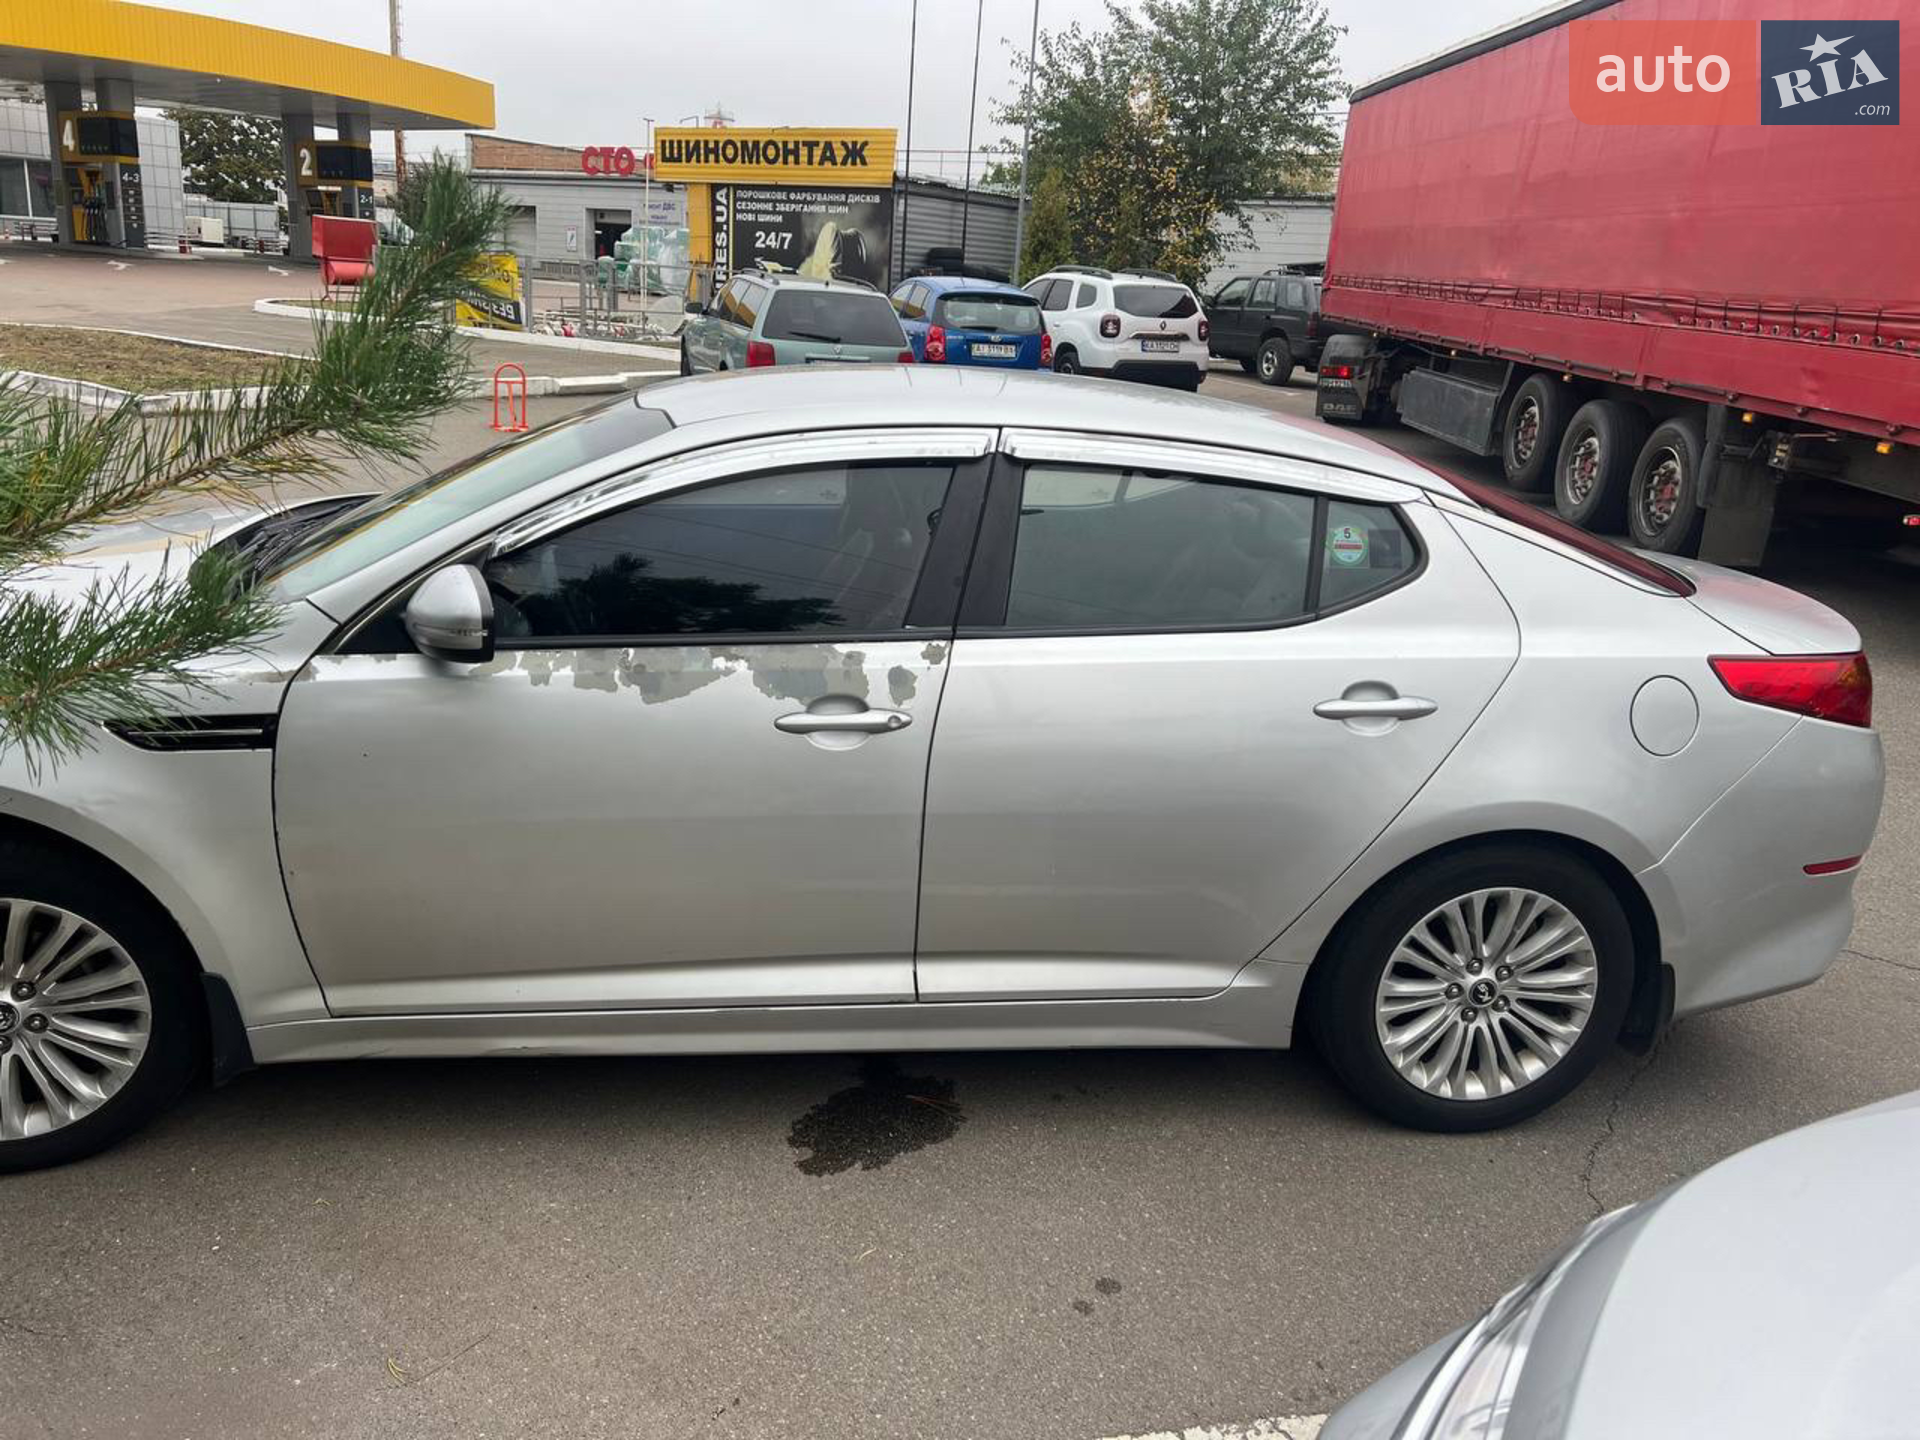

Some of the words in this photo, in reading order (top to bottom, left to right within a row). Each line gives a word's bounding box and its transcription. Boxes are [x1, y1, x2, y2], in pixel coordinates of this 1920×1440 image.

[63, 120, 75, 151] 4
[300, 147, 313, 176] 2
[582, 146, 635, 176] СТО
[660, 138, 869, 166] ШИНОМОНТАЖ
[122, 172, 140, 183] 4-3
[736, 190, 788, 200] ПОРОШКОВЕ
[789, 192, 846, 202] ФАРБУВАННЯ
[847, 194, 880, 204] ДИСКІВ
[736, 201, 773, 211] СЕЗОННЕ
[775, 203, 826, 213] ЗБЕРІГАННЯ
[828, 205, 849, 214] ШИН
[736, 213, 756, 221] НОВІ
[757, 214, 783, 223] ШИНИ
[715, 187, 728, 289] IRES.UA
[755, 231, 793, 250] 24/7
